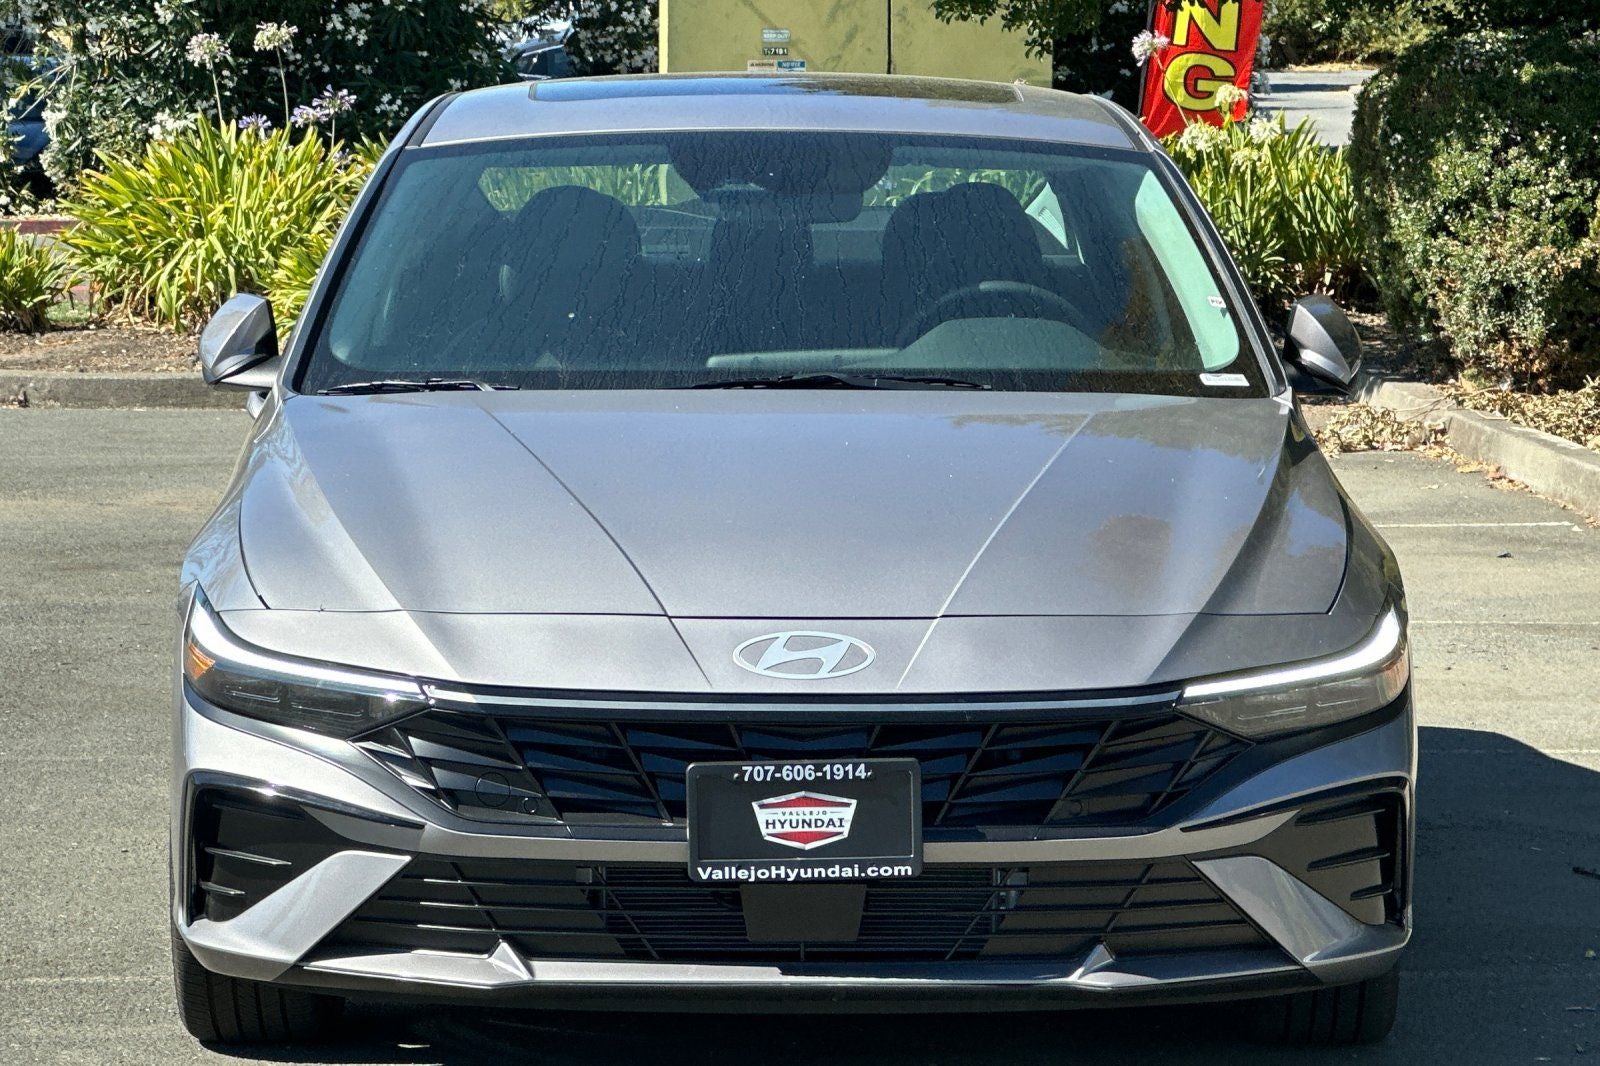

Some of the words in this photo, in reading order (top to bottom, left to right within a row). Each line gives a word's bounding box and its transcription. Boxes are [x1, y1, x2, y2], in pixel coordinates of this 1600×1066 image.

[741, 763, 866, 782] 707-606-1914
[765, 817, 845, 830] HYUNDAI
[697, 864, 913, 882] VallejoHyundai.com
